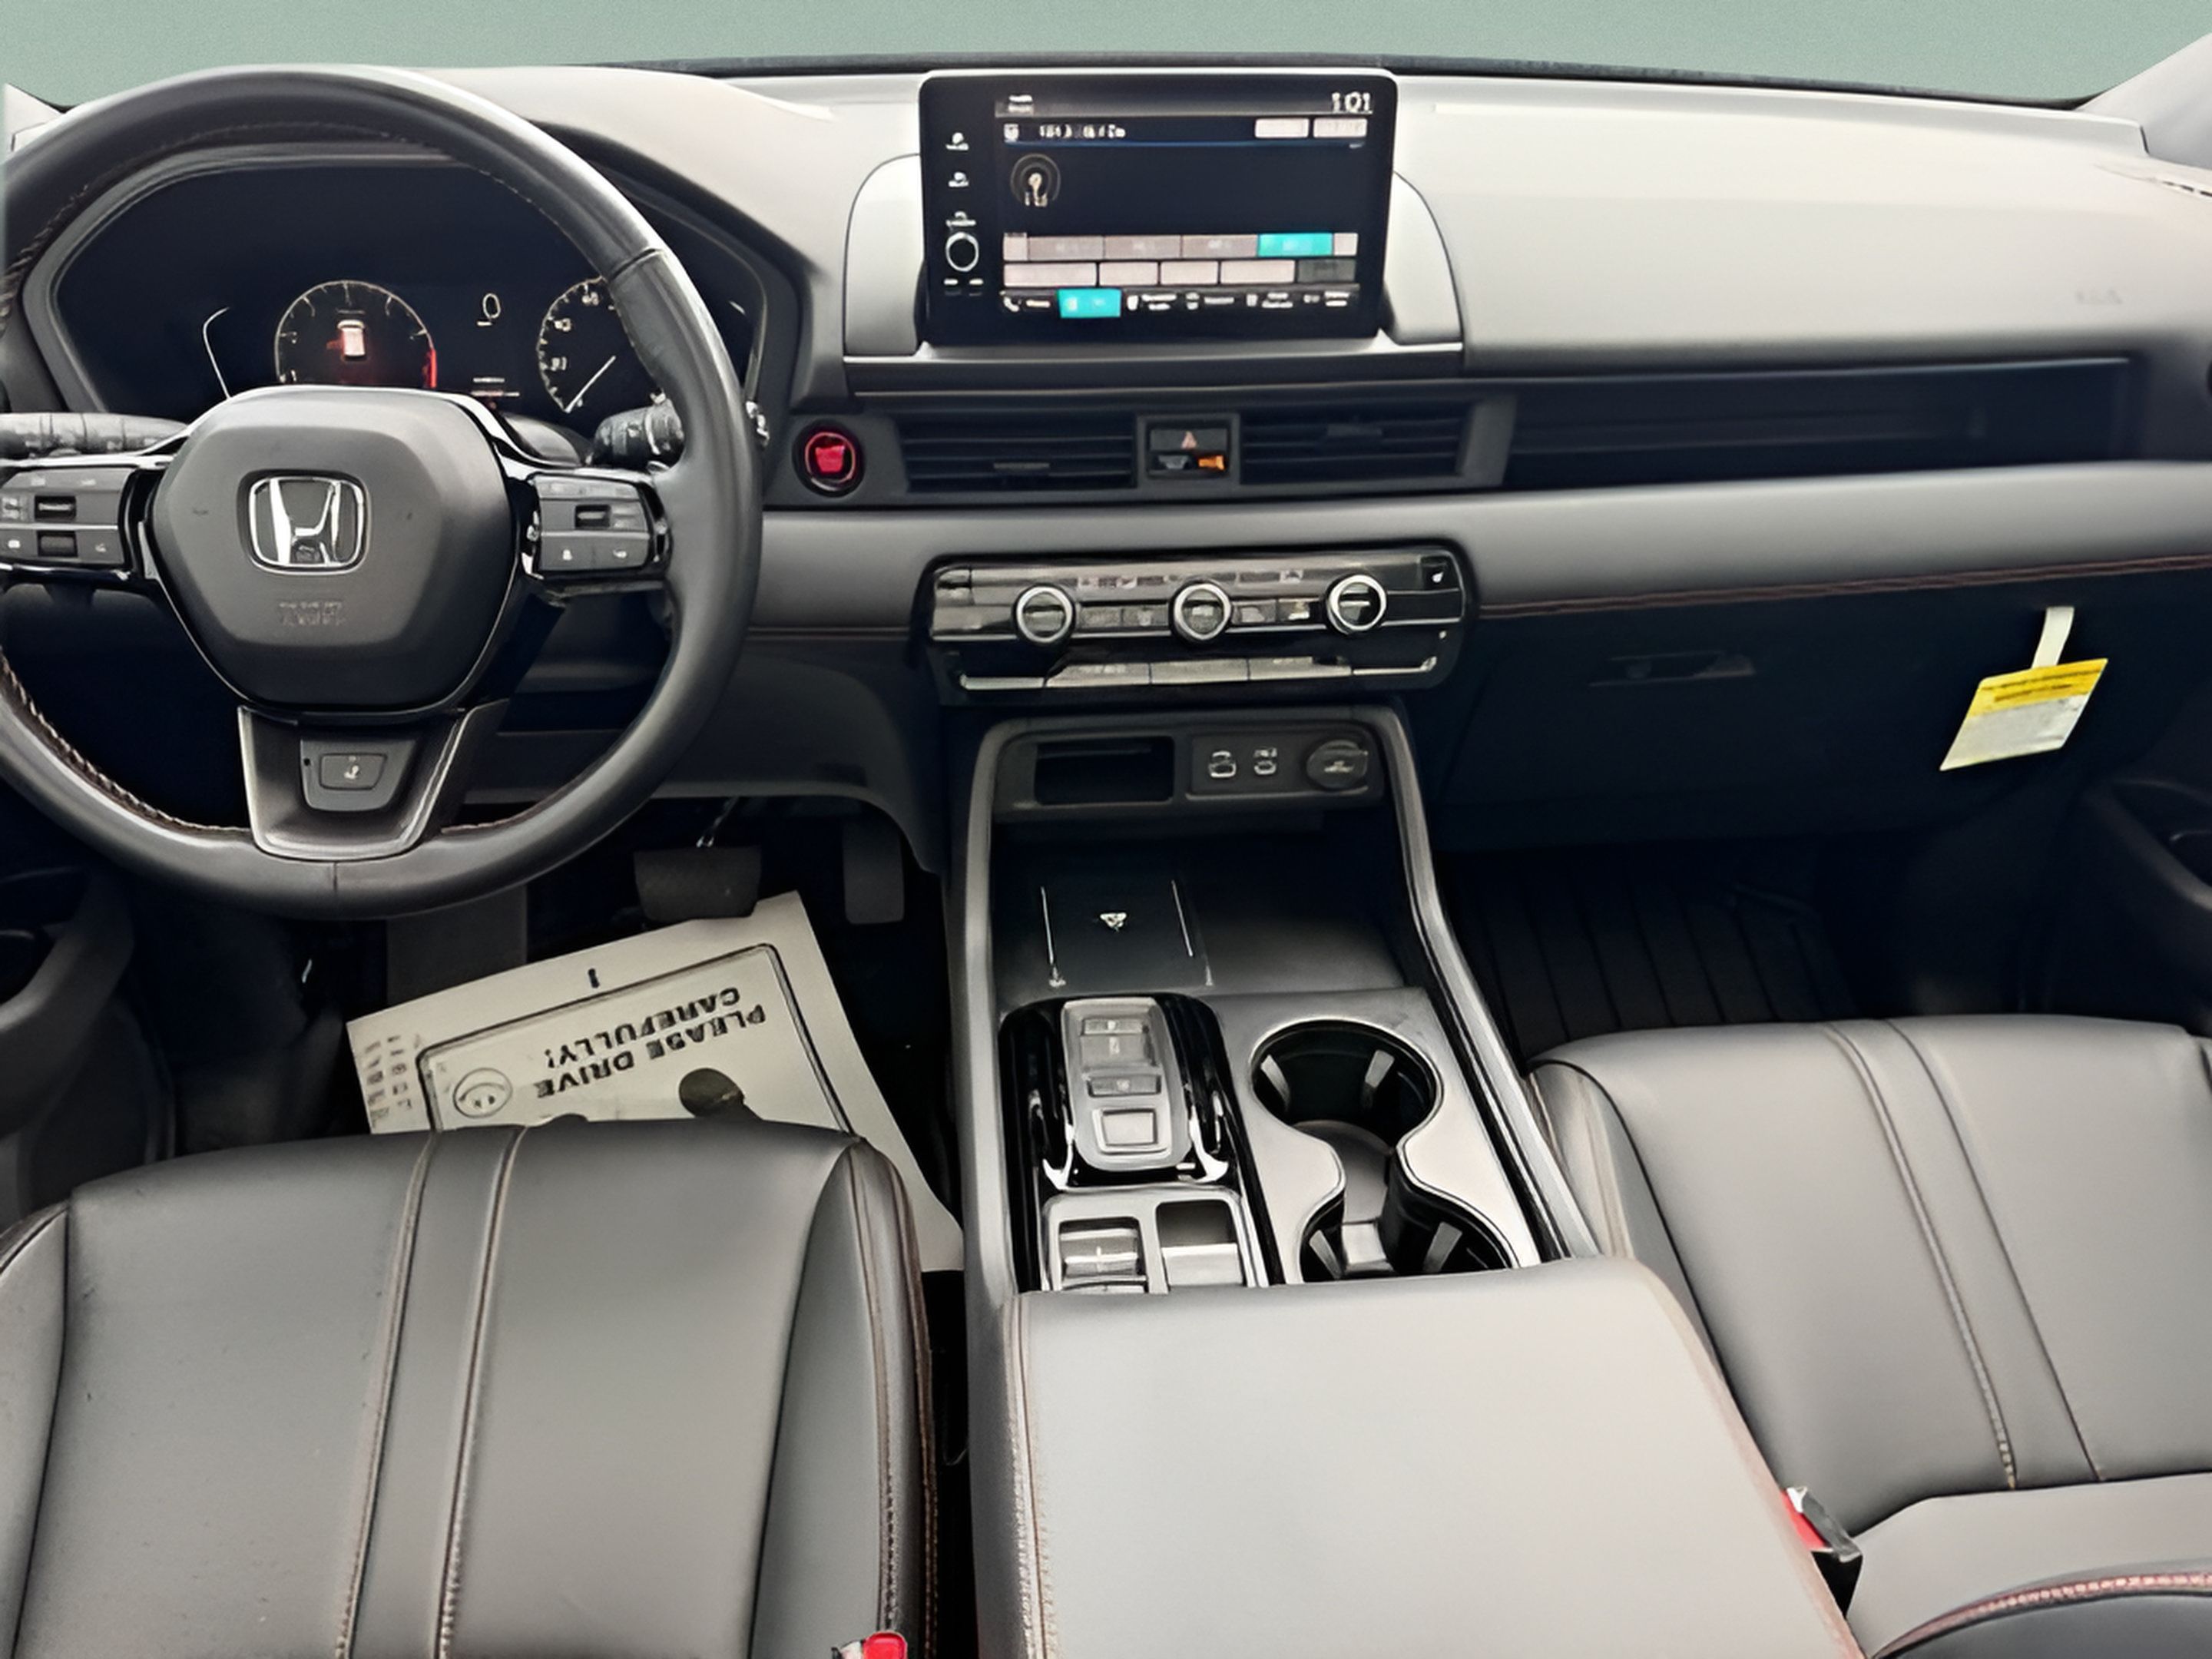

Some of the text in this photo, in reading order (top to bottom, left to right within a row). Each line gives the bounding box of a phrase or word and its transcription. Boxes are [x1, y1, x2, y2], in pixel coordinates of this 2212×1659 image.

[533, 1004, 767, 1098] PLEASE DRIVE
[544, 986, 740, 1068] CAREFULLY!
